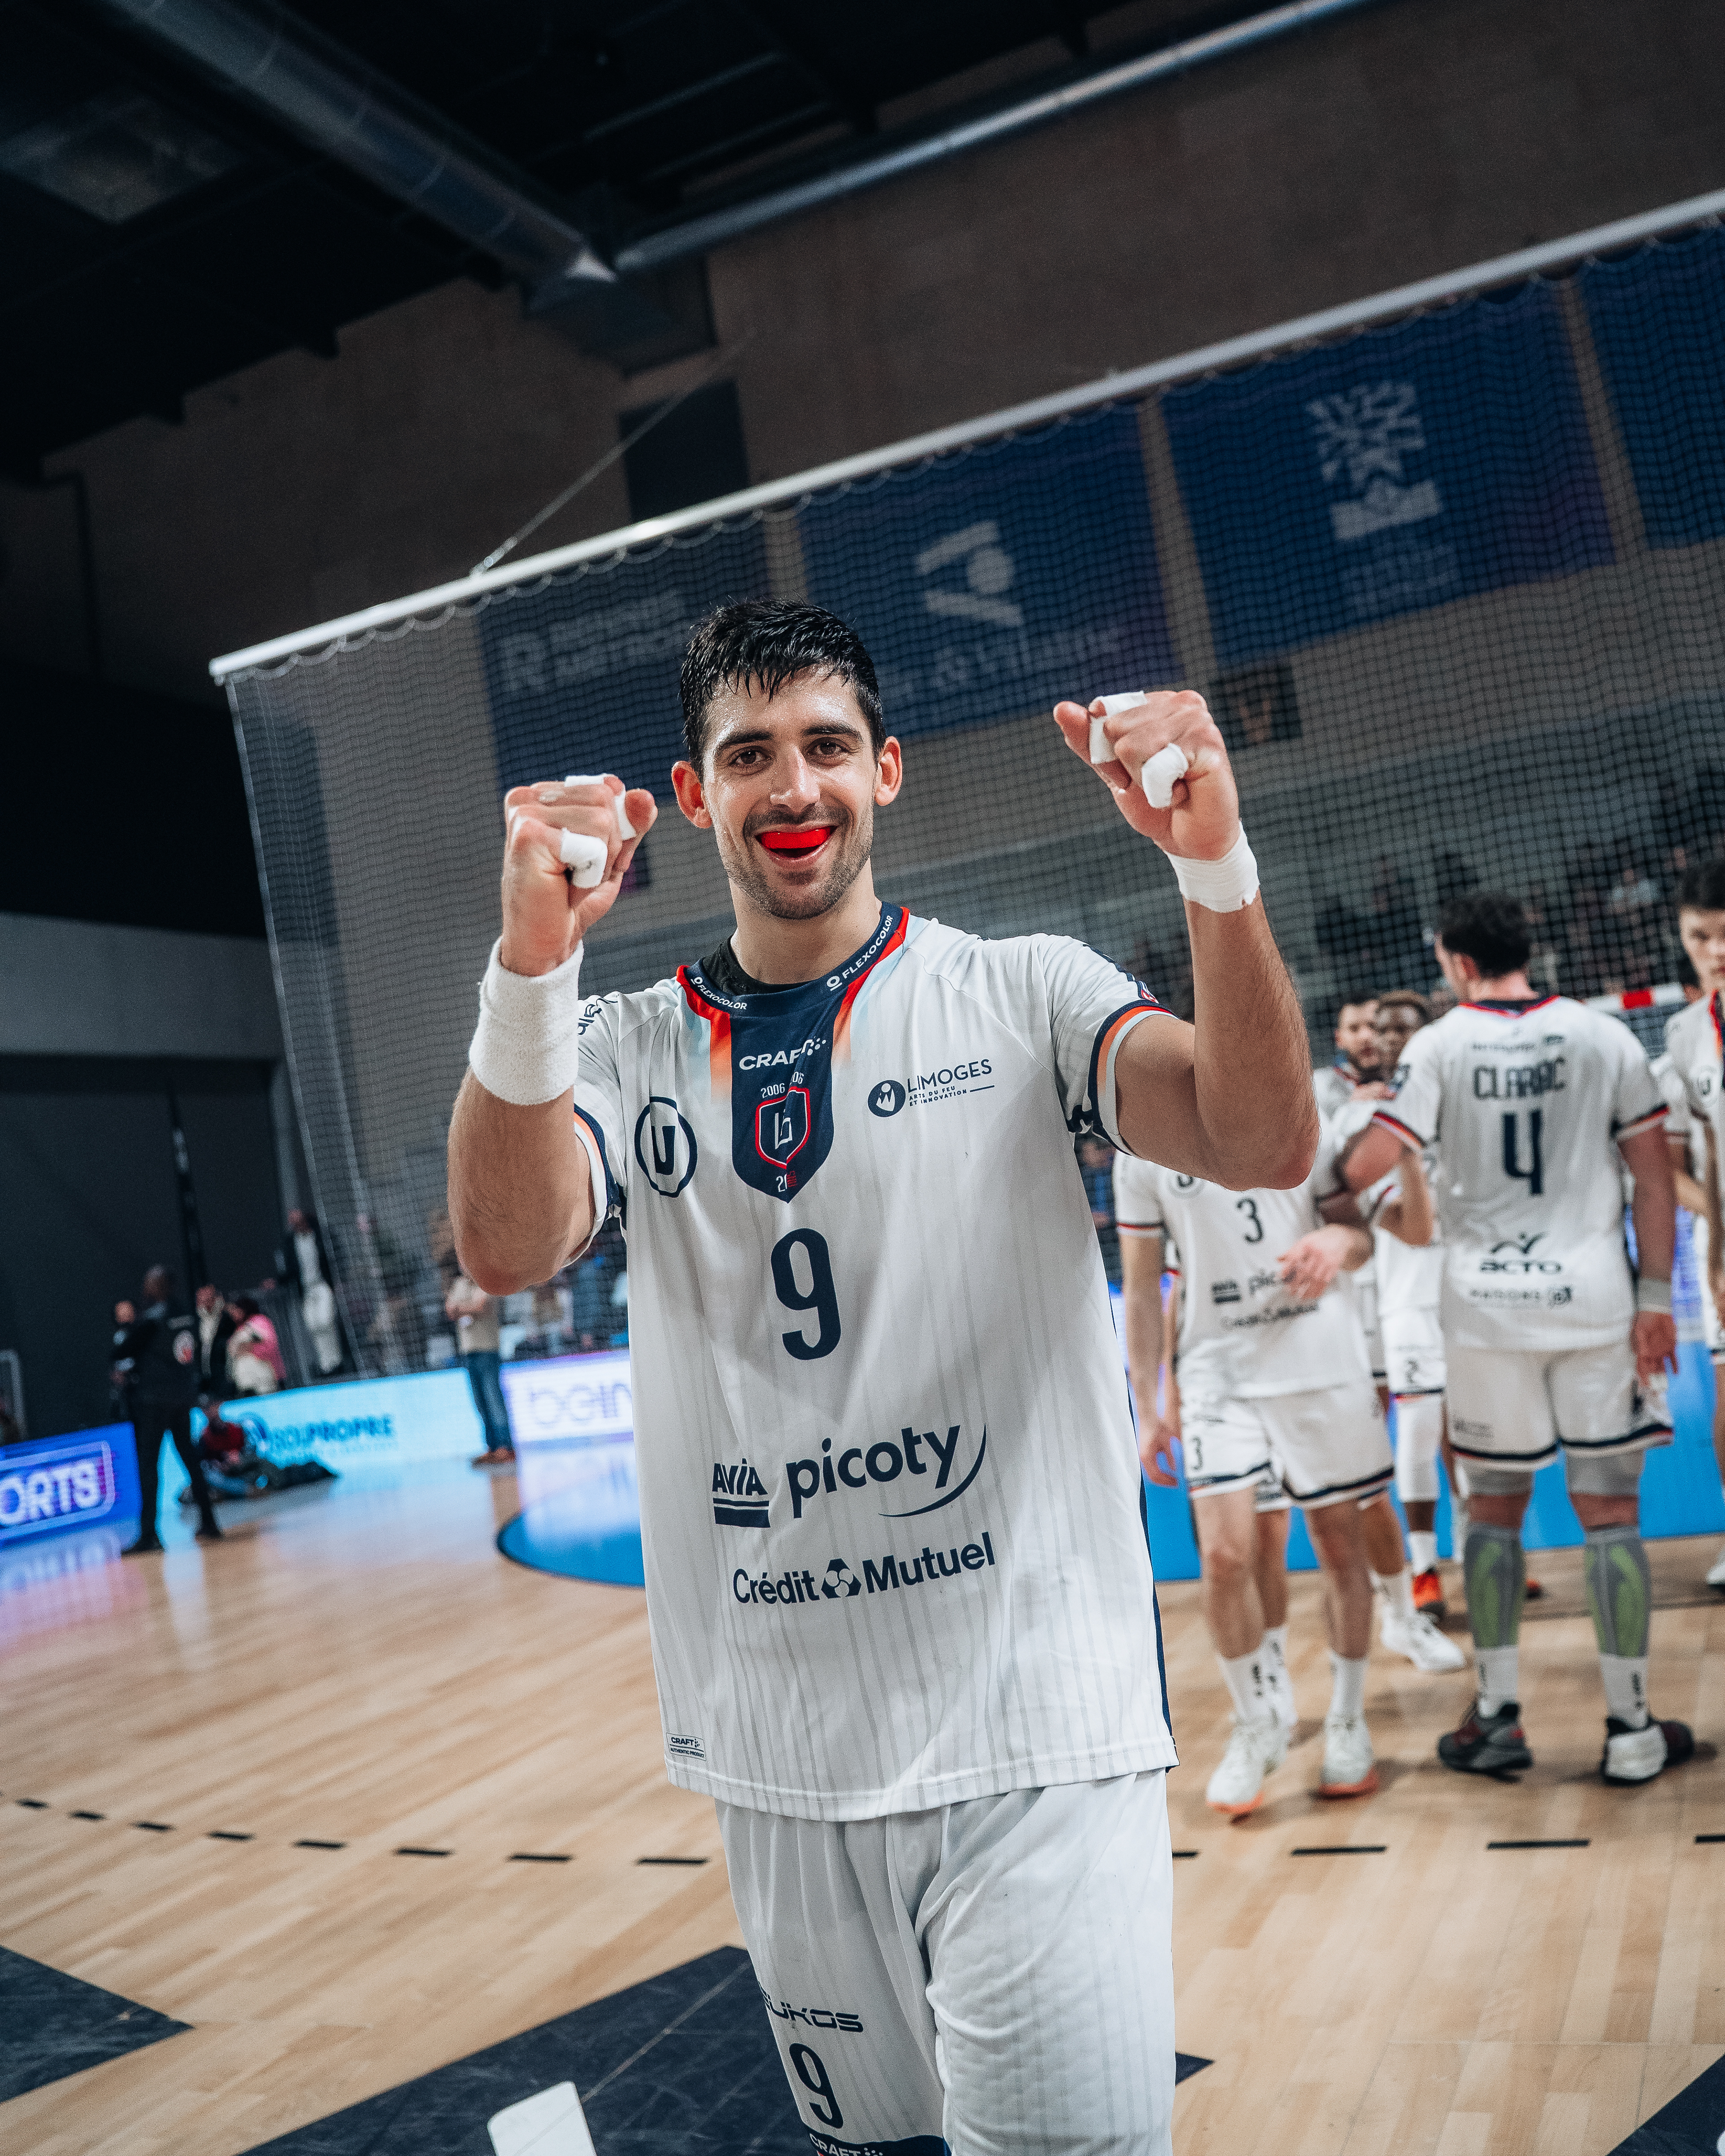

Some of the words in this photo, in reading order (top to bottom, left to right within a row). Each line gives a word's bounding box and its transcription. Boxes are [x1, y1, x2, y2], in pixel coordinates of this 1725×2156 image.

[842, 915, 893, 979] FLEXOCOLOR
[698, 985, 748, 1010] FLEXOCOLOR
[761, 1083, 785, 1099] 2006
[907, 1059, 992, 1093] LIMOGES
[909, 1093, 925, 1101] ARTS
[920, 1089, 967, 1104] INNOVATION
[1503, 1109, 1543, 1195] 4
[1237, 1197, 1264, 1244] 3
[770, 1228, 841, 1361] 9
[712, 1458, 768, 1496] AVIA
[786, 1425, 961, 1519] picoty
[733, 1568, 820, 1604] Crédit
[862, 1531, 995, 1594] Mutuel
[671, 1737, 694, 1745] CRAFT
[690, 1750, 705, 1759] PRODUCT
[789, 2042, 844, 2129] 9
